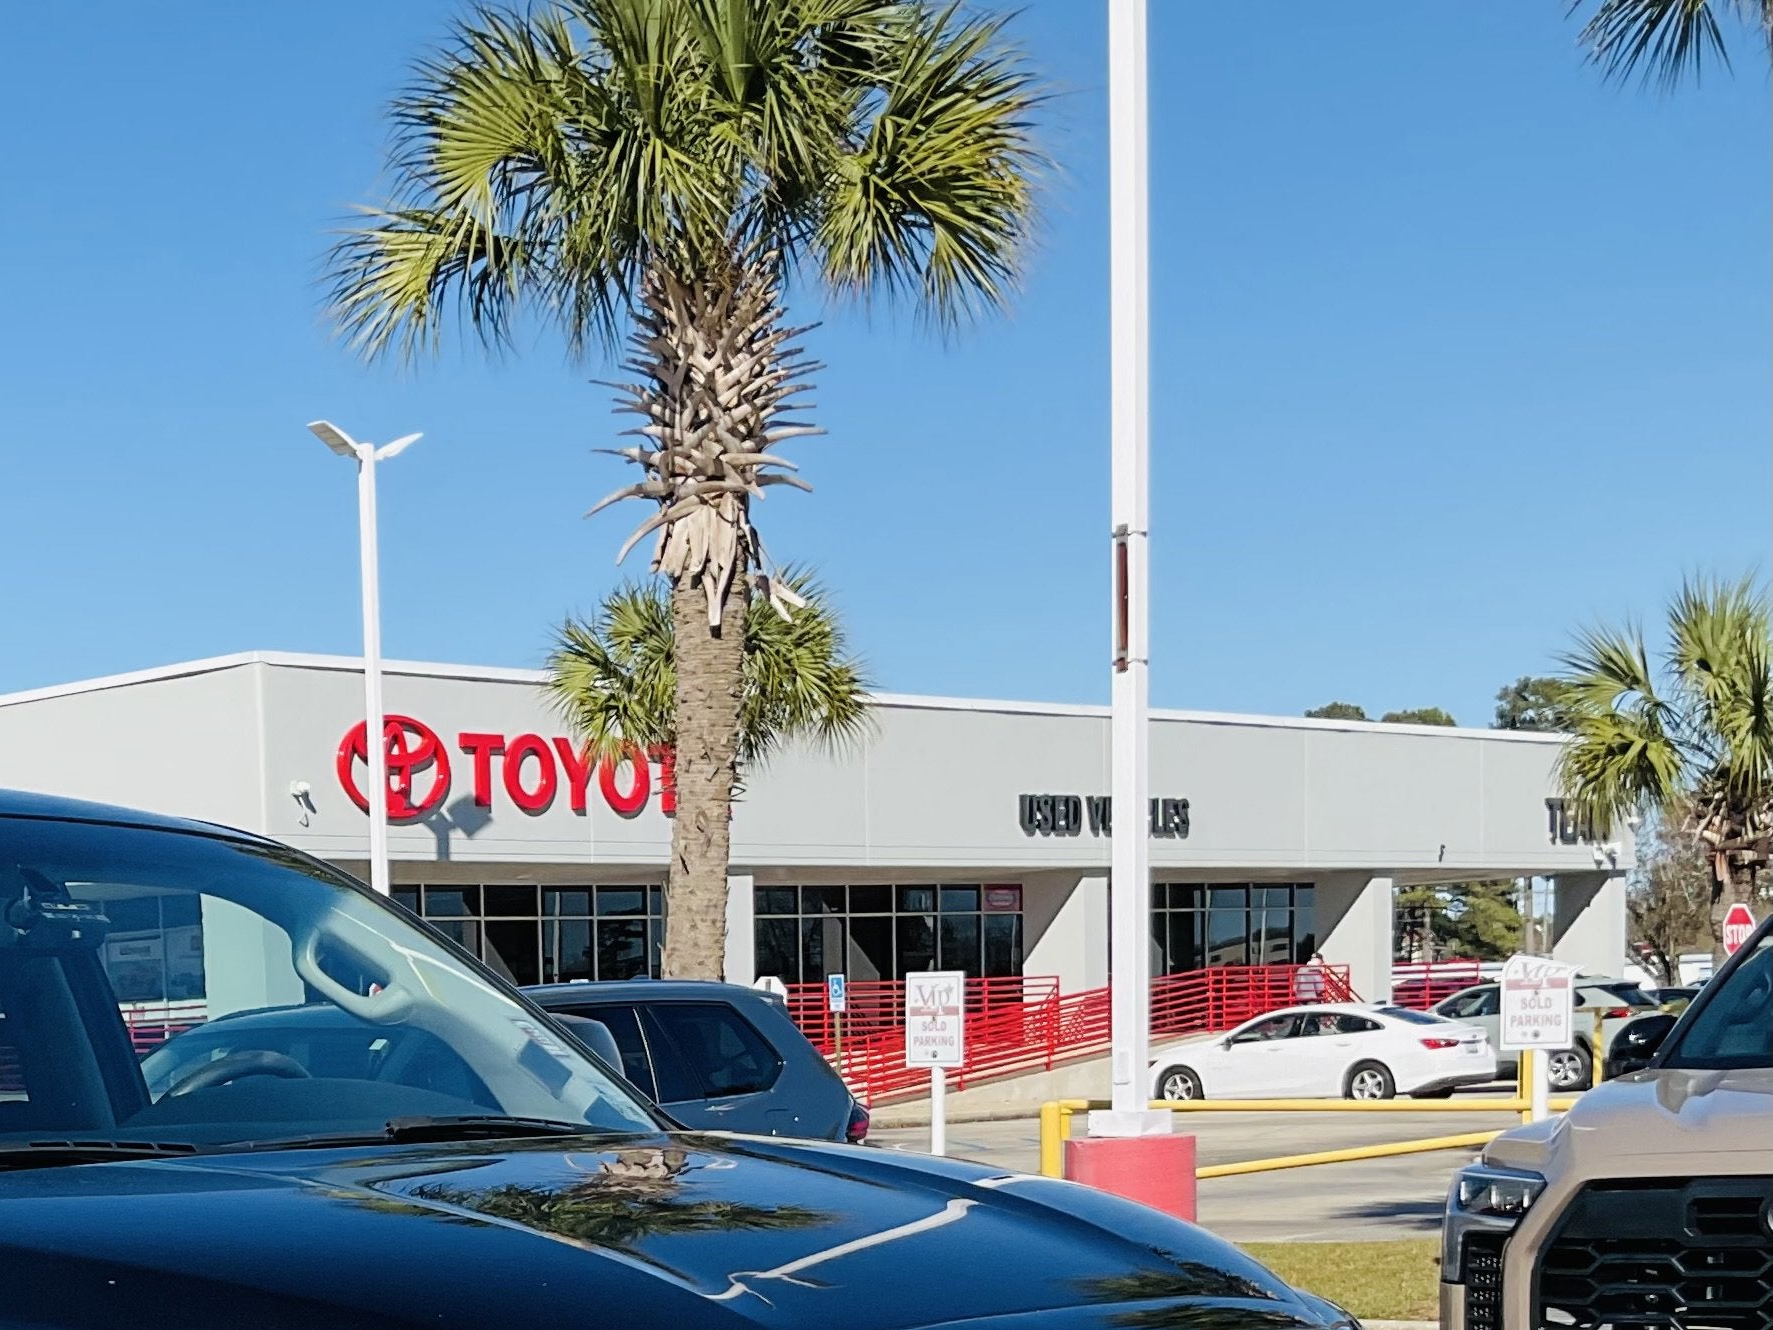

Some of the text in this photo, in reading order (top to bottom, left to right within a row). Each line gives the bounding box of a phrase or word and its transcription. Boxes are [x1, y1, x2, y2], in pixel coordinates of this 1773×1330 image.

[458, 732, 733, 821] TOYOT
[1018, 794, 1190, 840] USED VELES
[1521, 997, 1552, 1010] SOLD
[921, 1021, 947, 1032] SOLD
[1510, 1014, 1562, 1028] PARKING
[913, 1035, 955, 1047] PARKING
